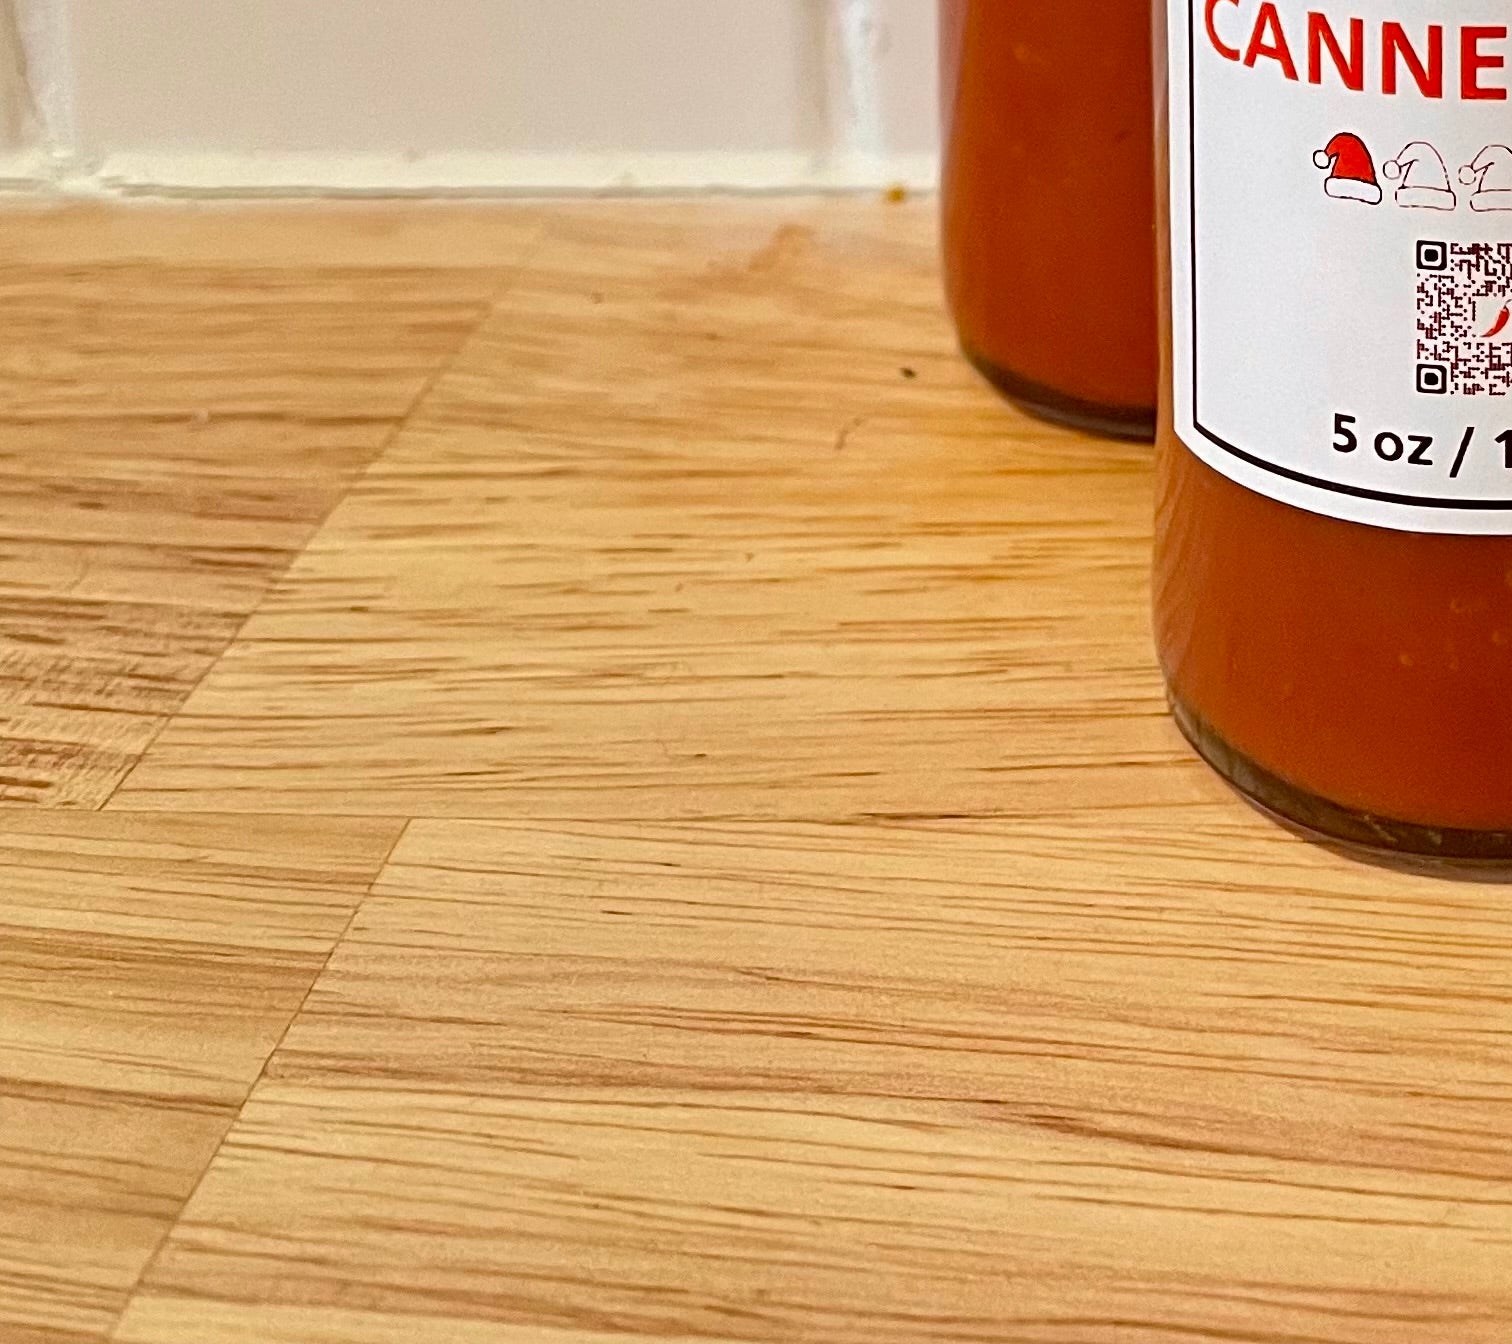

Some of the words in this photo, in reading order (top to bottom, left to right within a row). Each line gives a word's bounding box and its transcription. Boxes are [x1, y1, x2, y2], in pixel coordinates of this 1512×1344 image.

[1331, 412, 1358, 455] 5
[1373, 430, 1434, 468] oz
[1448, 425, 1476, 479] /
